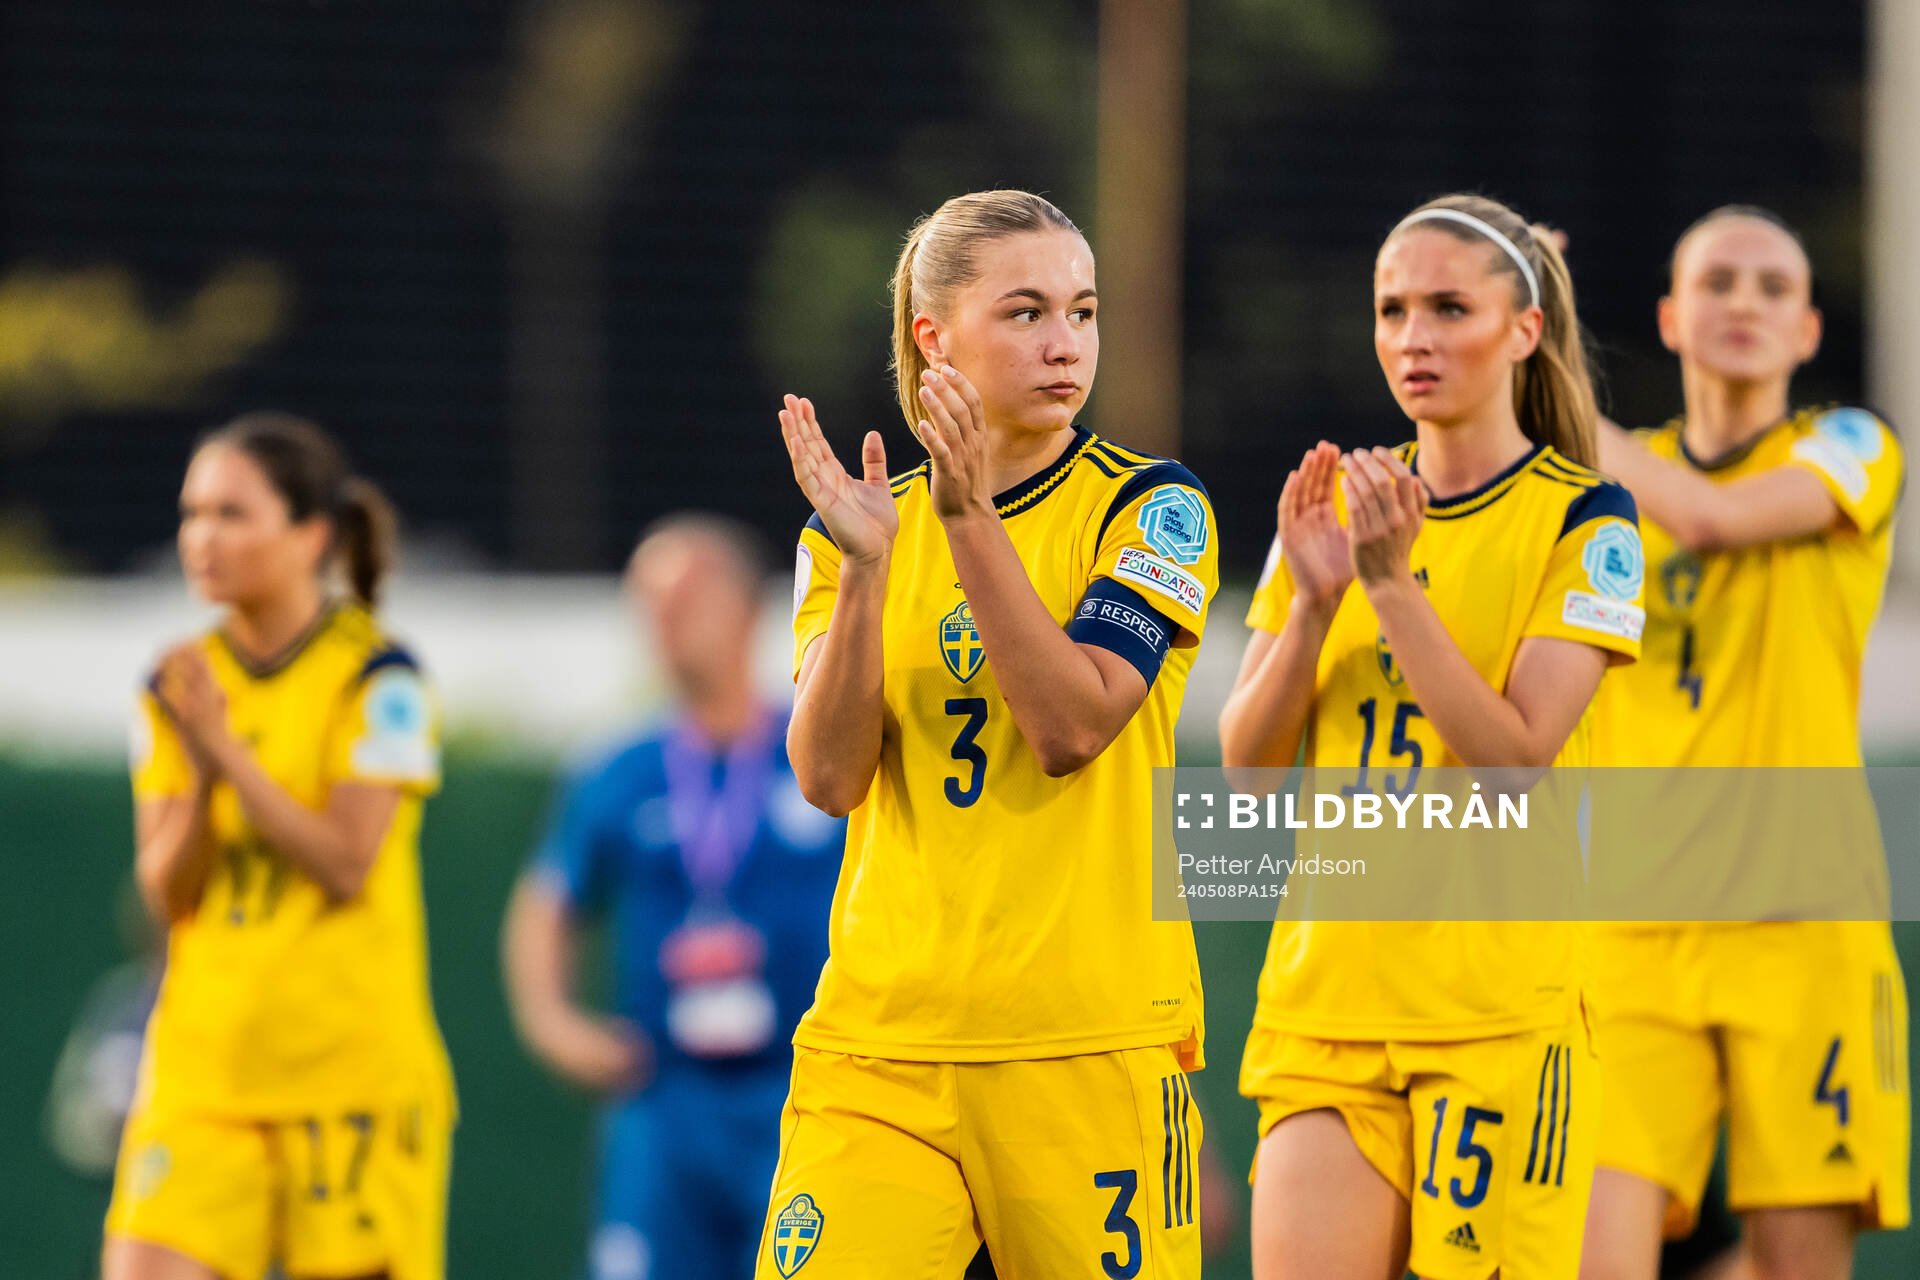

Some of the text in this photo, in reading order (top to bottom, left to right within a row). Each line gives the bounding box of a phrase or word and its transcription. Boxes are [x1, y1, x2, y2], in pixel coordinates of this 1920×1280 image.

[1123, 549, 1145, 560] UEFA
[1163, 523, 1192, 543] Strong
[1100, 603, 1163, 646] RESPECT
[1119, 556, 1203, 605] FOUNDATION
[943, 697, 988, 809] 3
[1341, 696, 1425, 801] 15
[1814, 1036, 1850, 1128] 4
[303, 1110, 375, 1200] 17
[1420, 1096, 1505, 1209] 15
[783, 1219, 813, 1227] SVERIGE
[1094, 1169, 1143, 1280] 3
